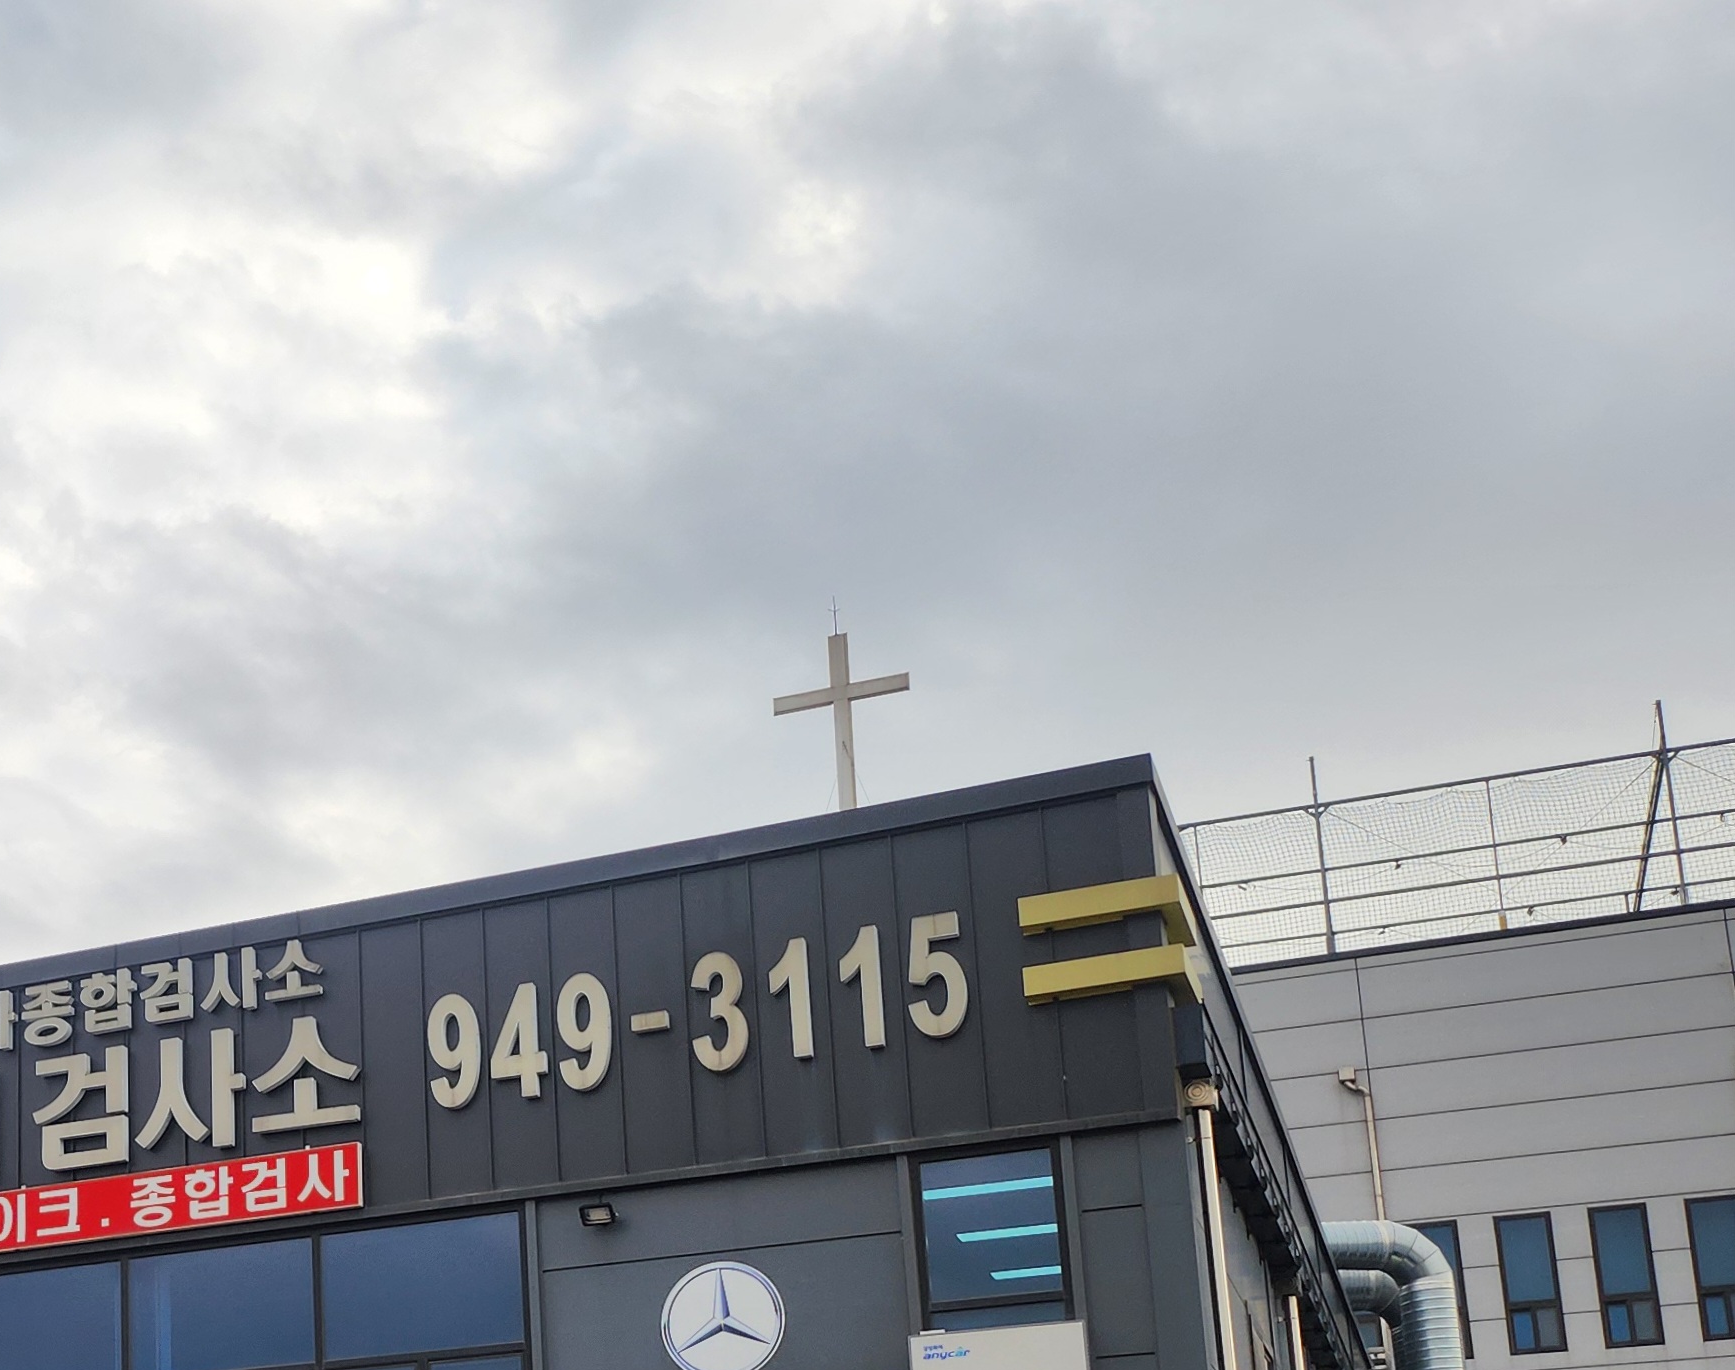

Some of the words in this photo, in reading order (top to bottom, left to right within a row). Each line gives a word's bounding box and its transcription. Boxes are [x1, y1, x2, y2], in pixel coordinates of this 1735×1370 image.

[427, 911, 968, 1110] 949-3115
[32, 1016, 362, 1171] 검사소
[129, 1149, 350, 1228] 종합검사
[922, 1347, 971, 1360] anycar
